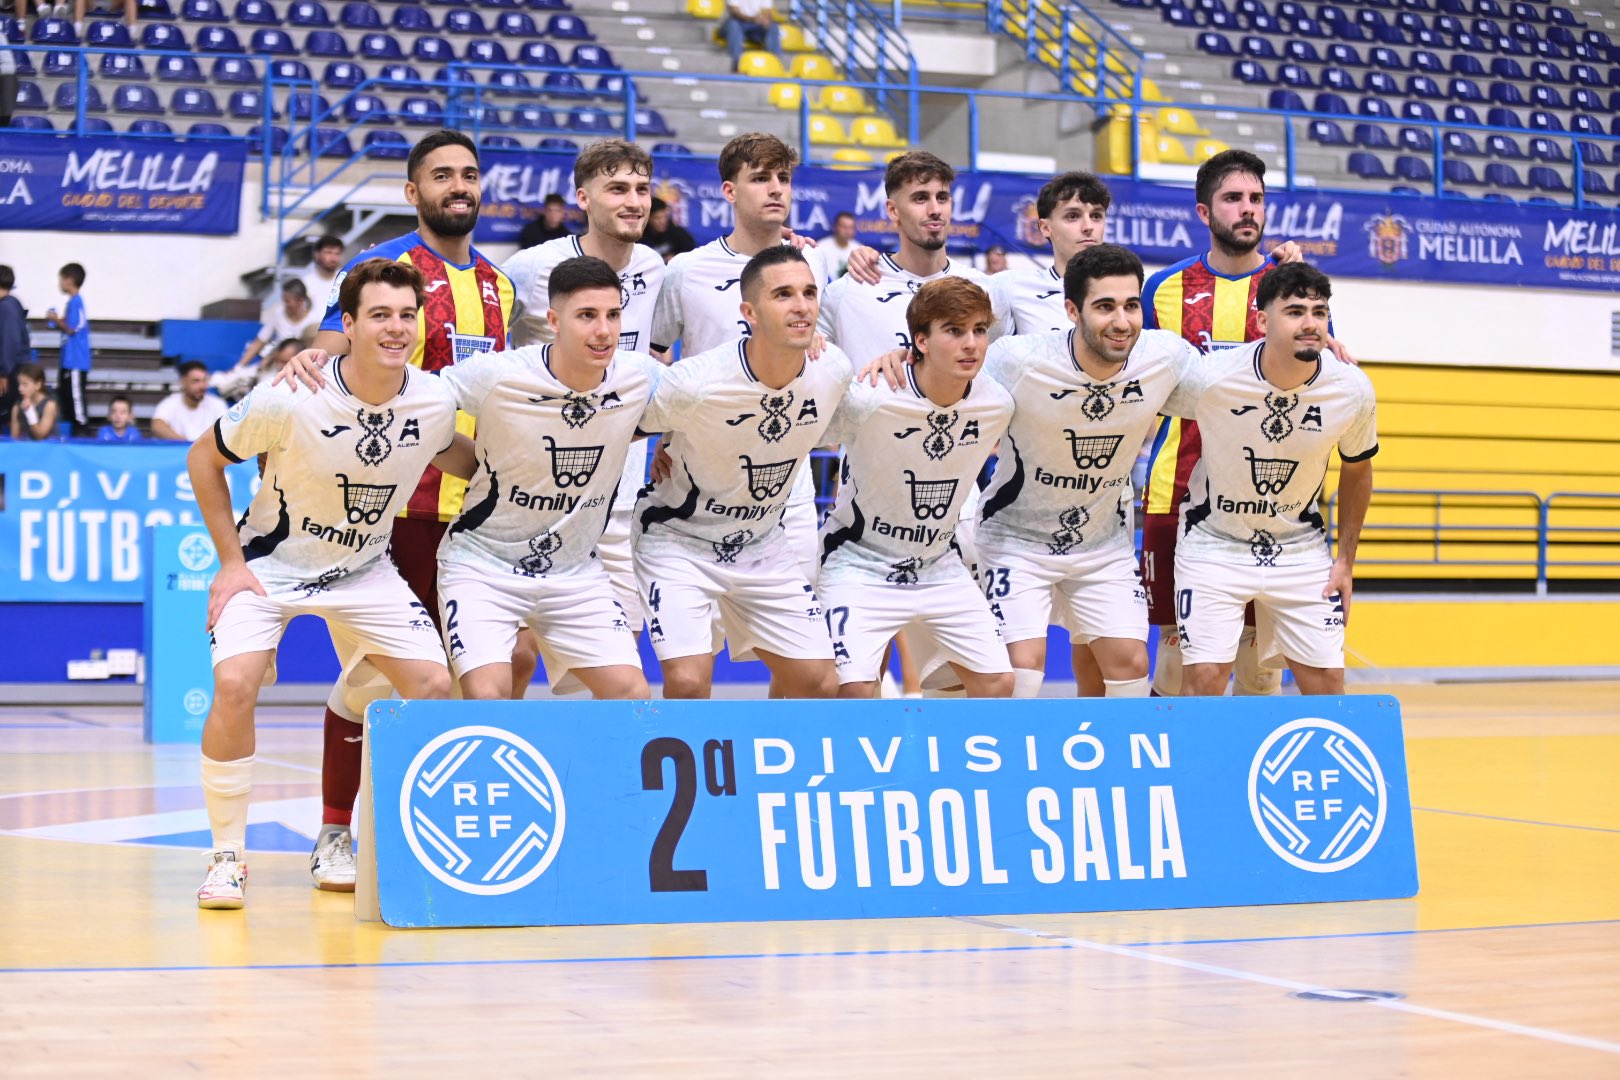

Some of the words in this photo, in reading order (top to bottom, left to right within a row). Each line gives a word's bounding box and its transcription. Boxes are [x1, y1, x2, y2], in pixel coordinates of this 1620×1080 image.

[62, 148, 218, 193] MELILLA
[1104, 217, 1193, 249] ELILLA
[1265, 203, 1343, 240] LILLA
[1543, 217, 1620, 256] MELIL
[1418, 233, 1524, 266] MELILLA
[20, 498, 206, 583] FÚTB
[649, 581, 661, 613] 4
[985, 567, 1010, 601] 23
[446, 599, 459, 633] 2
[825, 605, 850, 639] 17
[754, 721, 1170, 775] DIVISIÓN
[757, 774, 1008, 890] FÚTBOL
[1026, 786, 1187, 883] SALA
